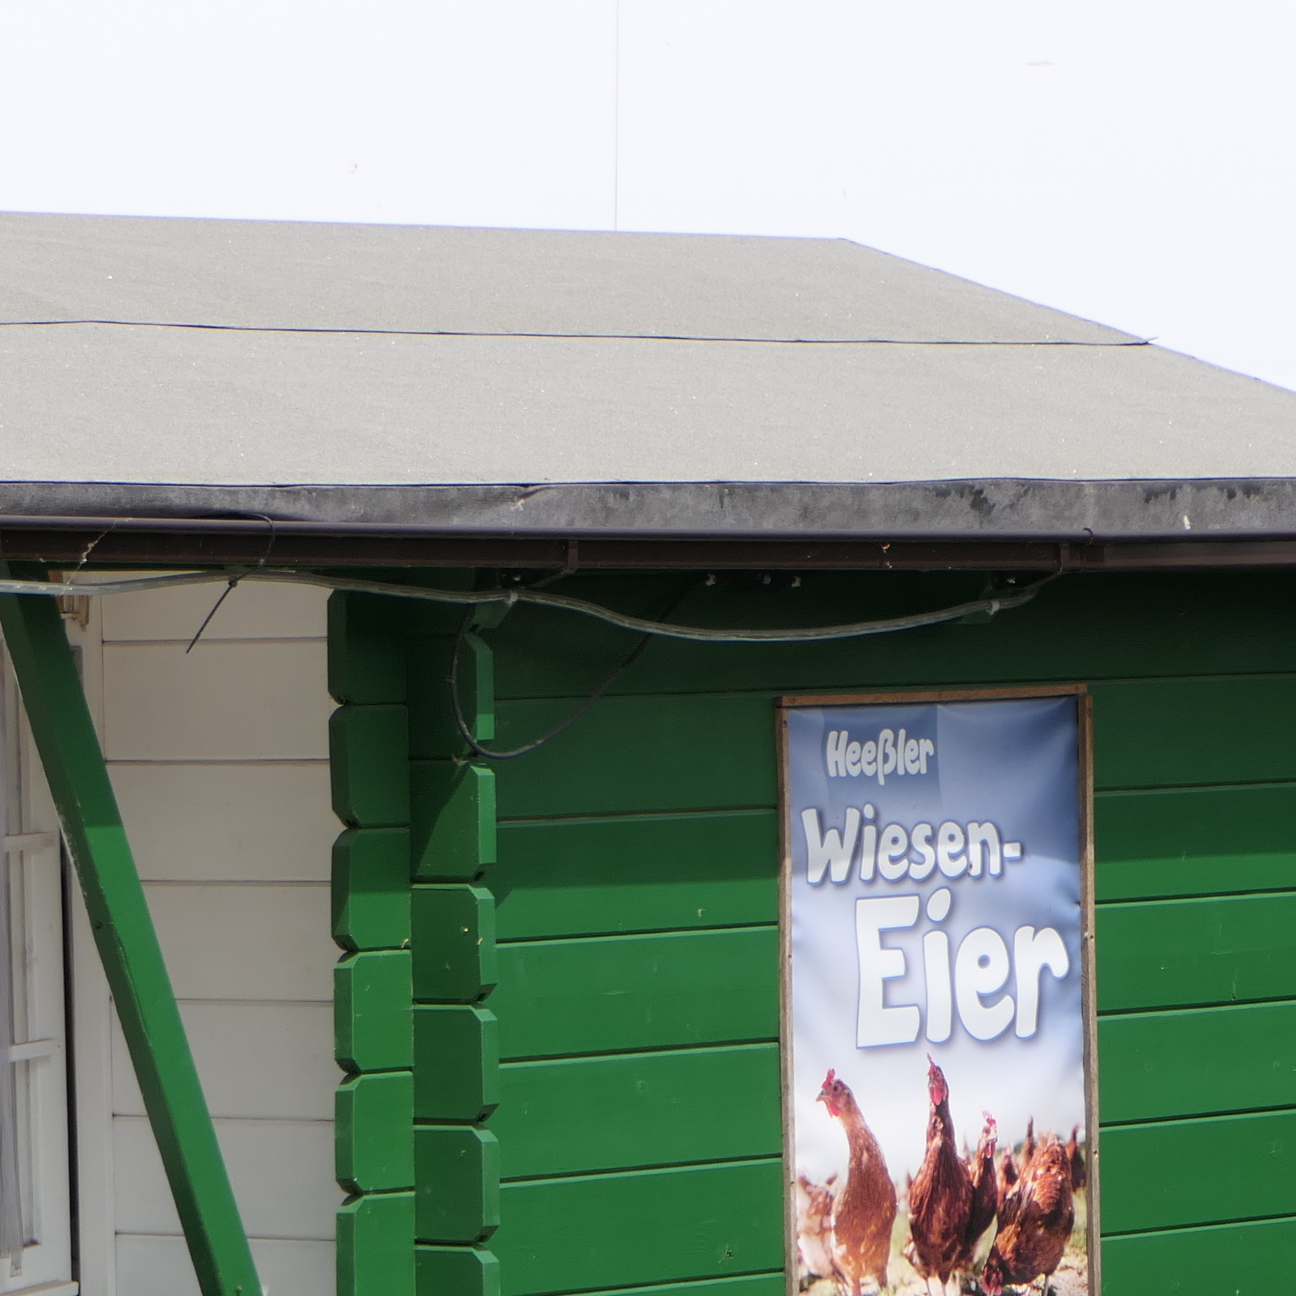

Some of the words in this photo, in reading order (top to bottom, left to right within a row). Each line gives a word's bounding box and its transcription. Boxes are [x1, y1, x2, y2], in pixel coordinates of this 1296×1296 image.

[826, 728, 934, 786] Heeßler
[801, 804, 1021, 885] Wiesen-
[856, 888, 1069, 1050] Eier
